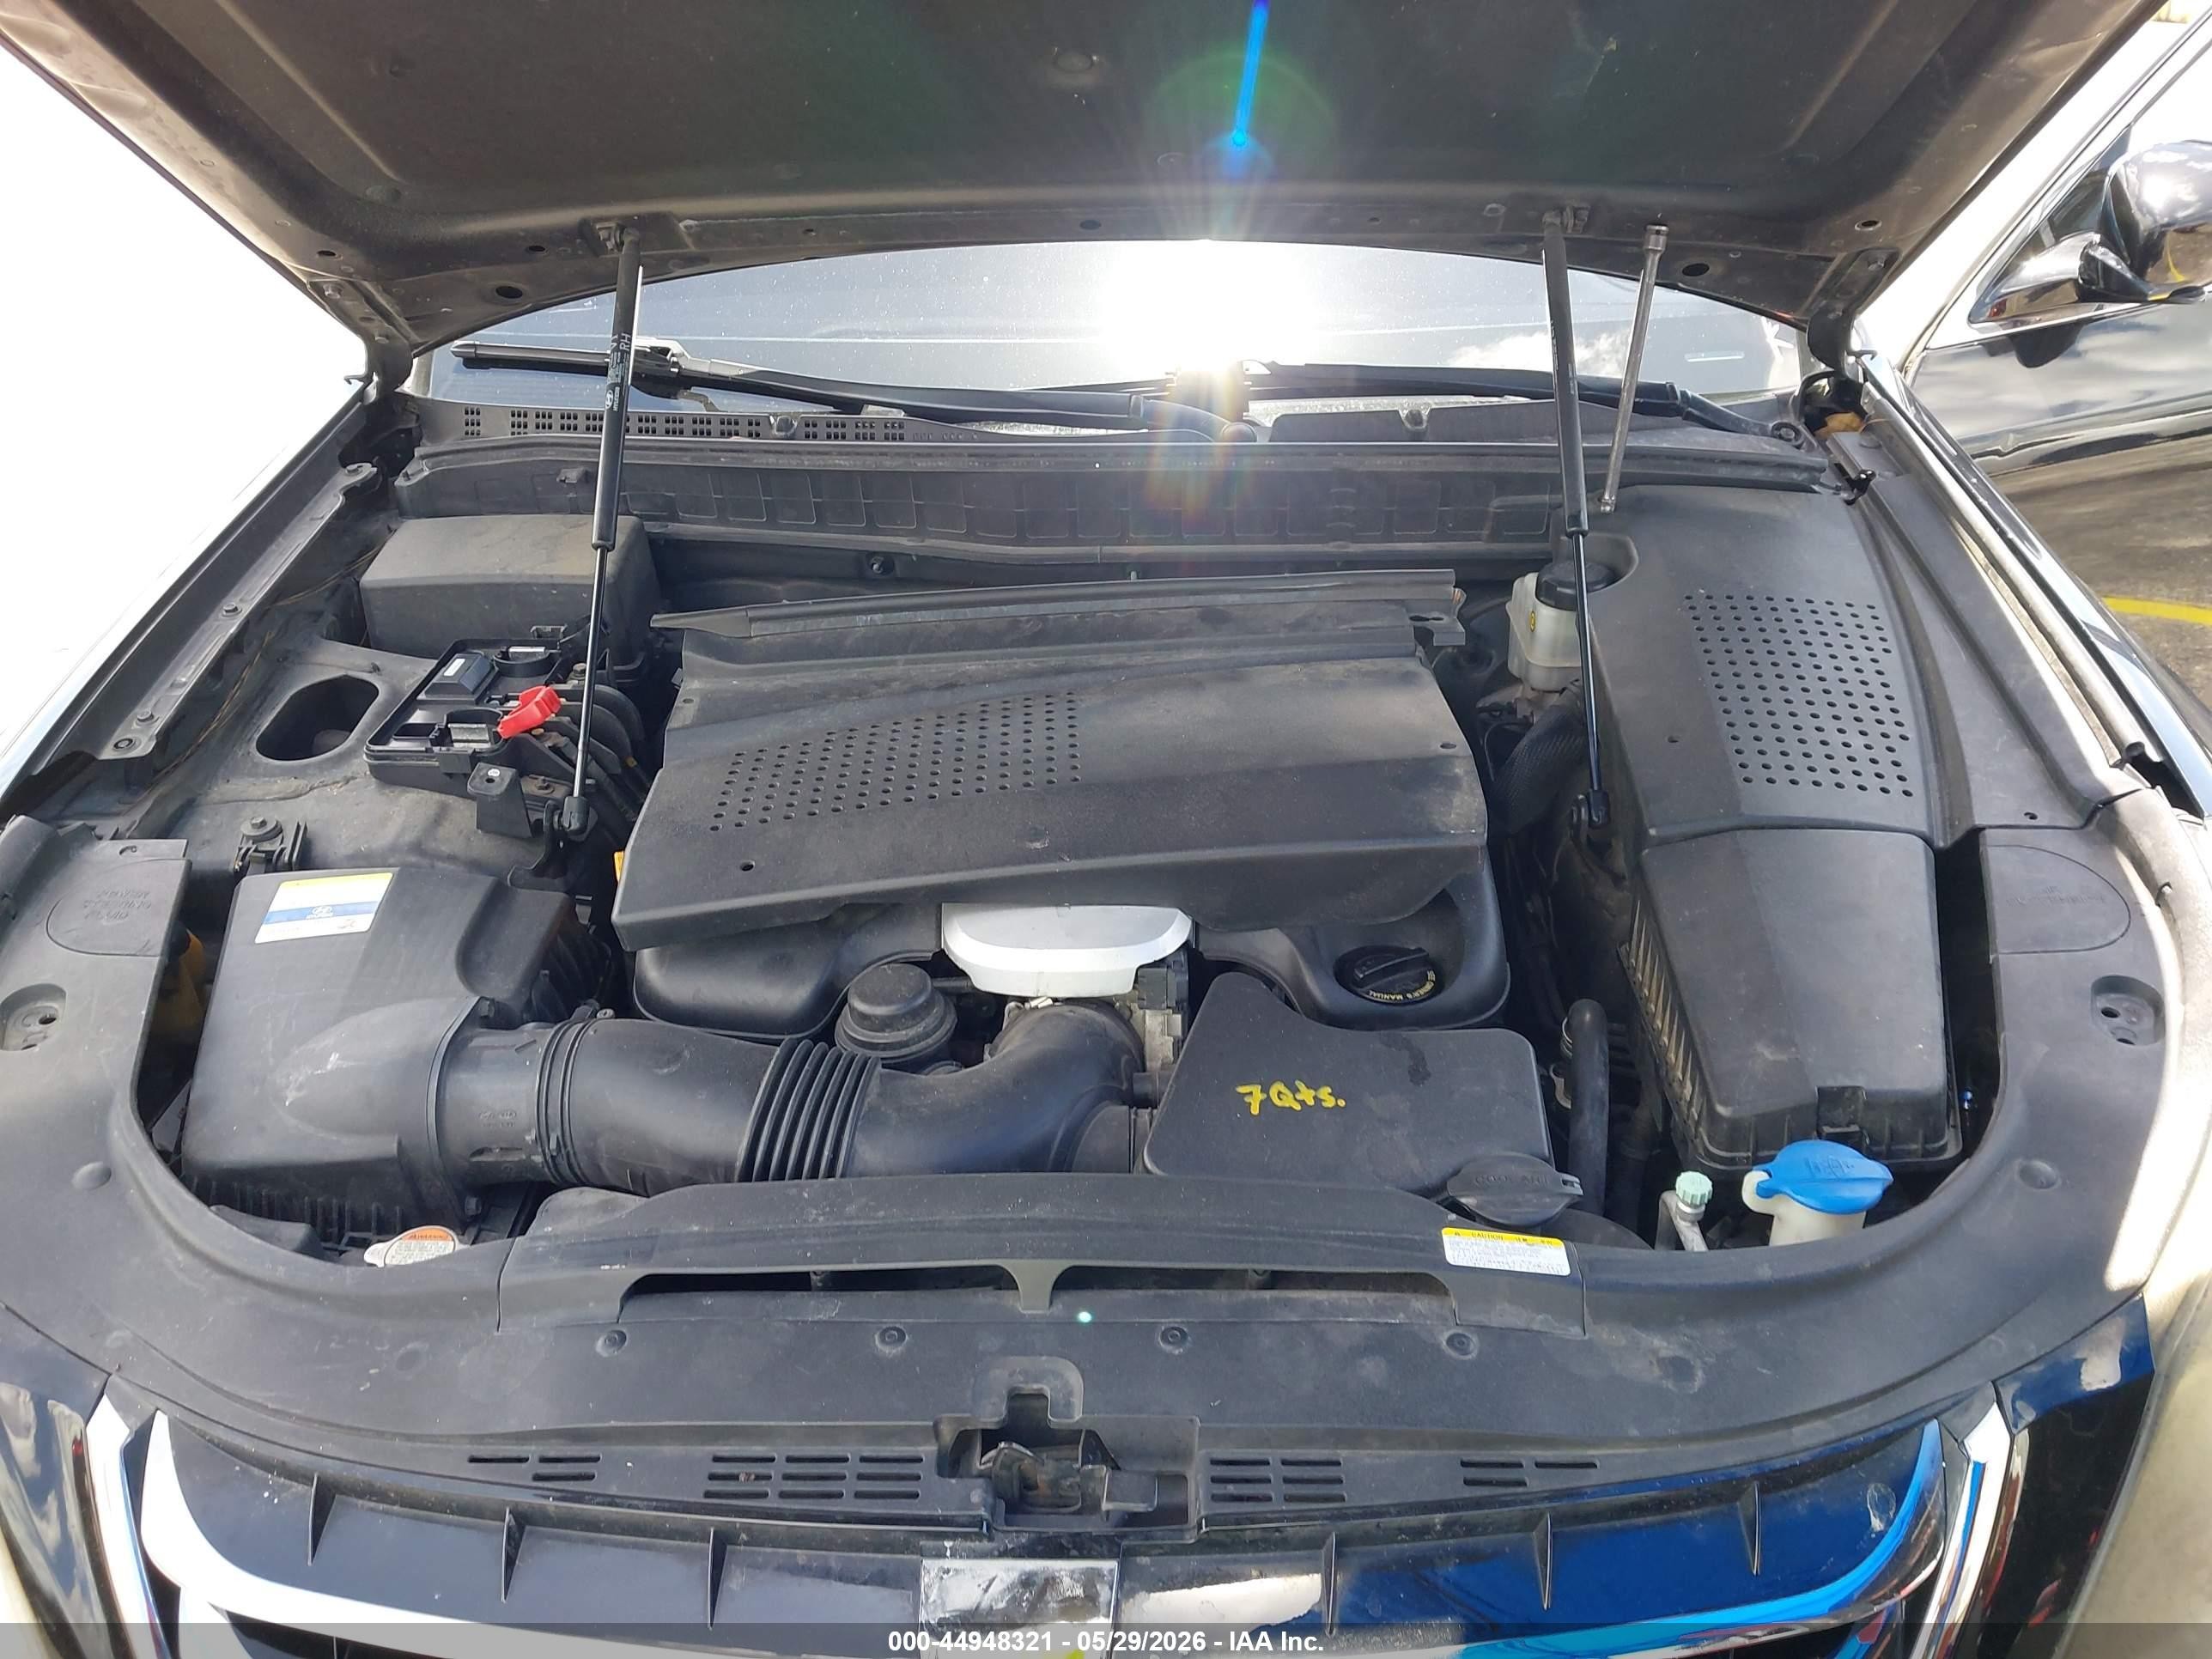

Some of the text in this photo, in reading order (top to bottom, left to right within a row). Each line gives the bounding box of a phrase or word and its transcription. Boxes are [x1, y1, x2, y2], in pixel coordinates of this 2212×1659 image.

[619, 332, 631, 351] RH
[1369, 989, 1403, 1000] MANUAL
[1474, 1173, 1551, 1186] COOANT
[1471, 1231, 1504, 1242] CAUTION
